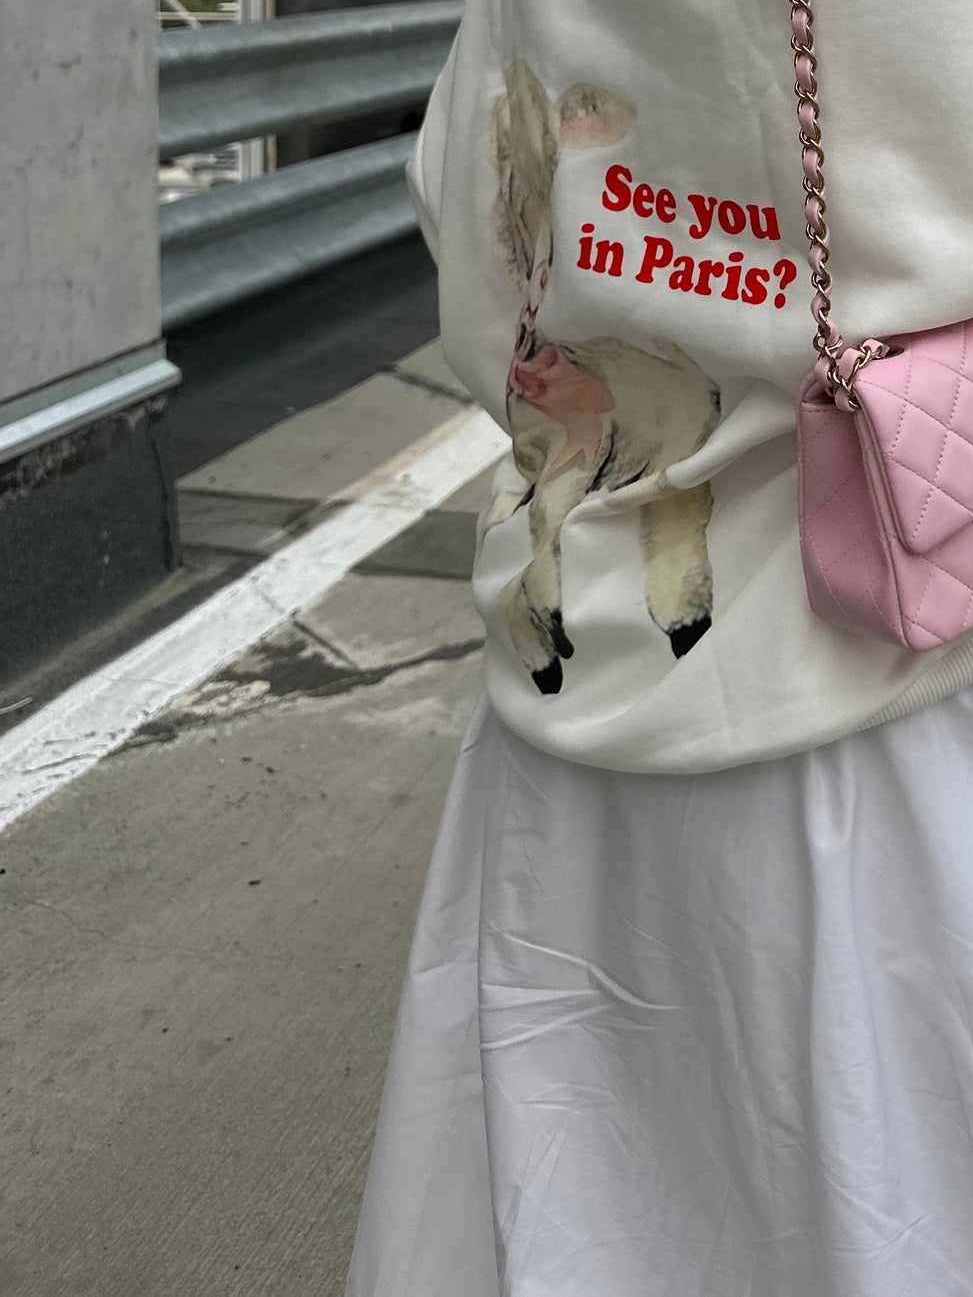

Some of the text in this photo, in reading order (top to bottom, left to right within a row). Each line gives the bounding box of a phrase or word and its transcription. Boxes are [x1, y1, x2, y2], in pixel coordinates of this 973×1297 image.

[602, 164, 780, 240] See you
[577, 223, 797, 309] in Paris?
